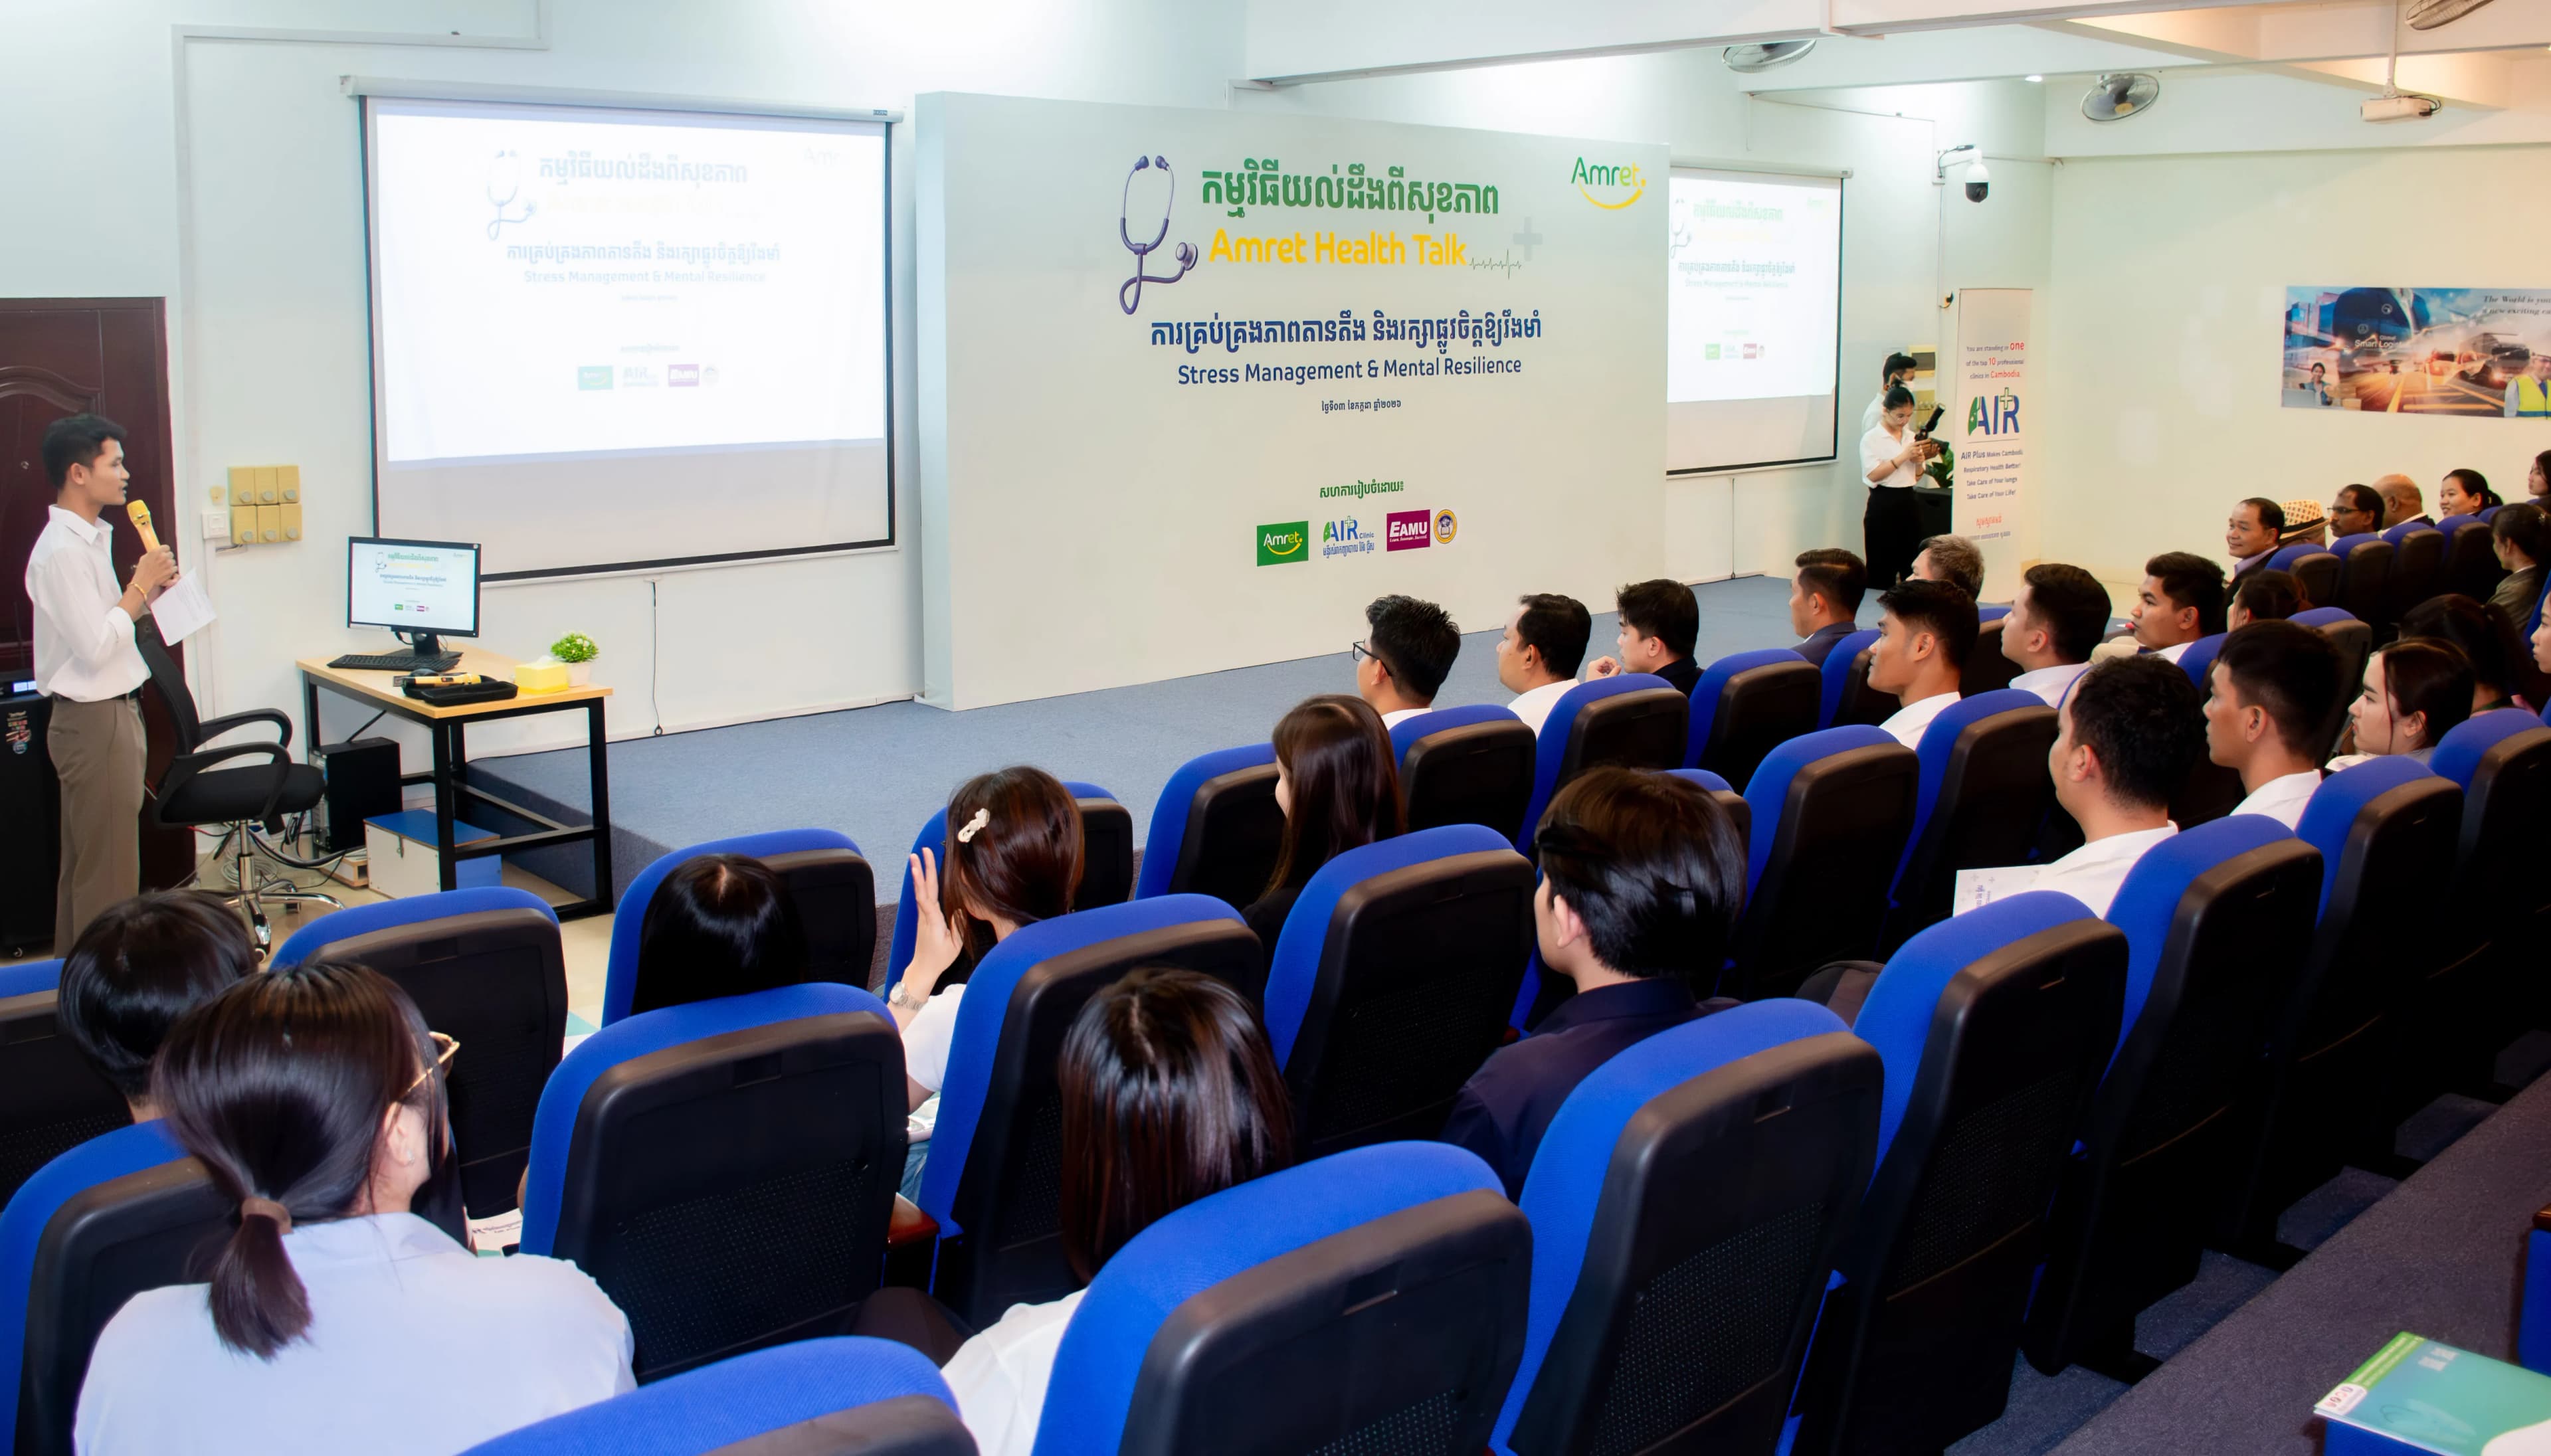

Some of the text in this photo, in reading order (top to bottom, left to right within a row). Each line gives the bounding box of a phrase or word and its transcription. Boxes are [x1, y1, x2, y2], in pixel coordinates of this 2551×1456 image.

[1202, 158, 1498, 224] កម្មវិធីយល់ដឹងពីសុខភាព
[1209, 228, 1466, 266] Amret Health Talk
[523, 270, 767, 285] Stress Management & Mental Resilience
[1151, 310, 1365, 353] ការគ្រប់គ្រងភាពតានតឹង
[2010, 341, 2025, 351] one
[1179, 356, 1522, 385] Stress Management & Mental Resilience
[1989, 357, 1996, 366] 10
[1968, 395, 2020, 436] AIR
[1323, 518, 1359, 543] AIR
[1389, 521, 1428, 537] EAMU
